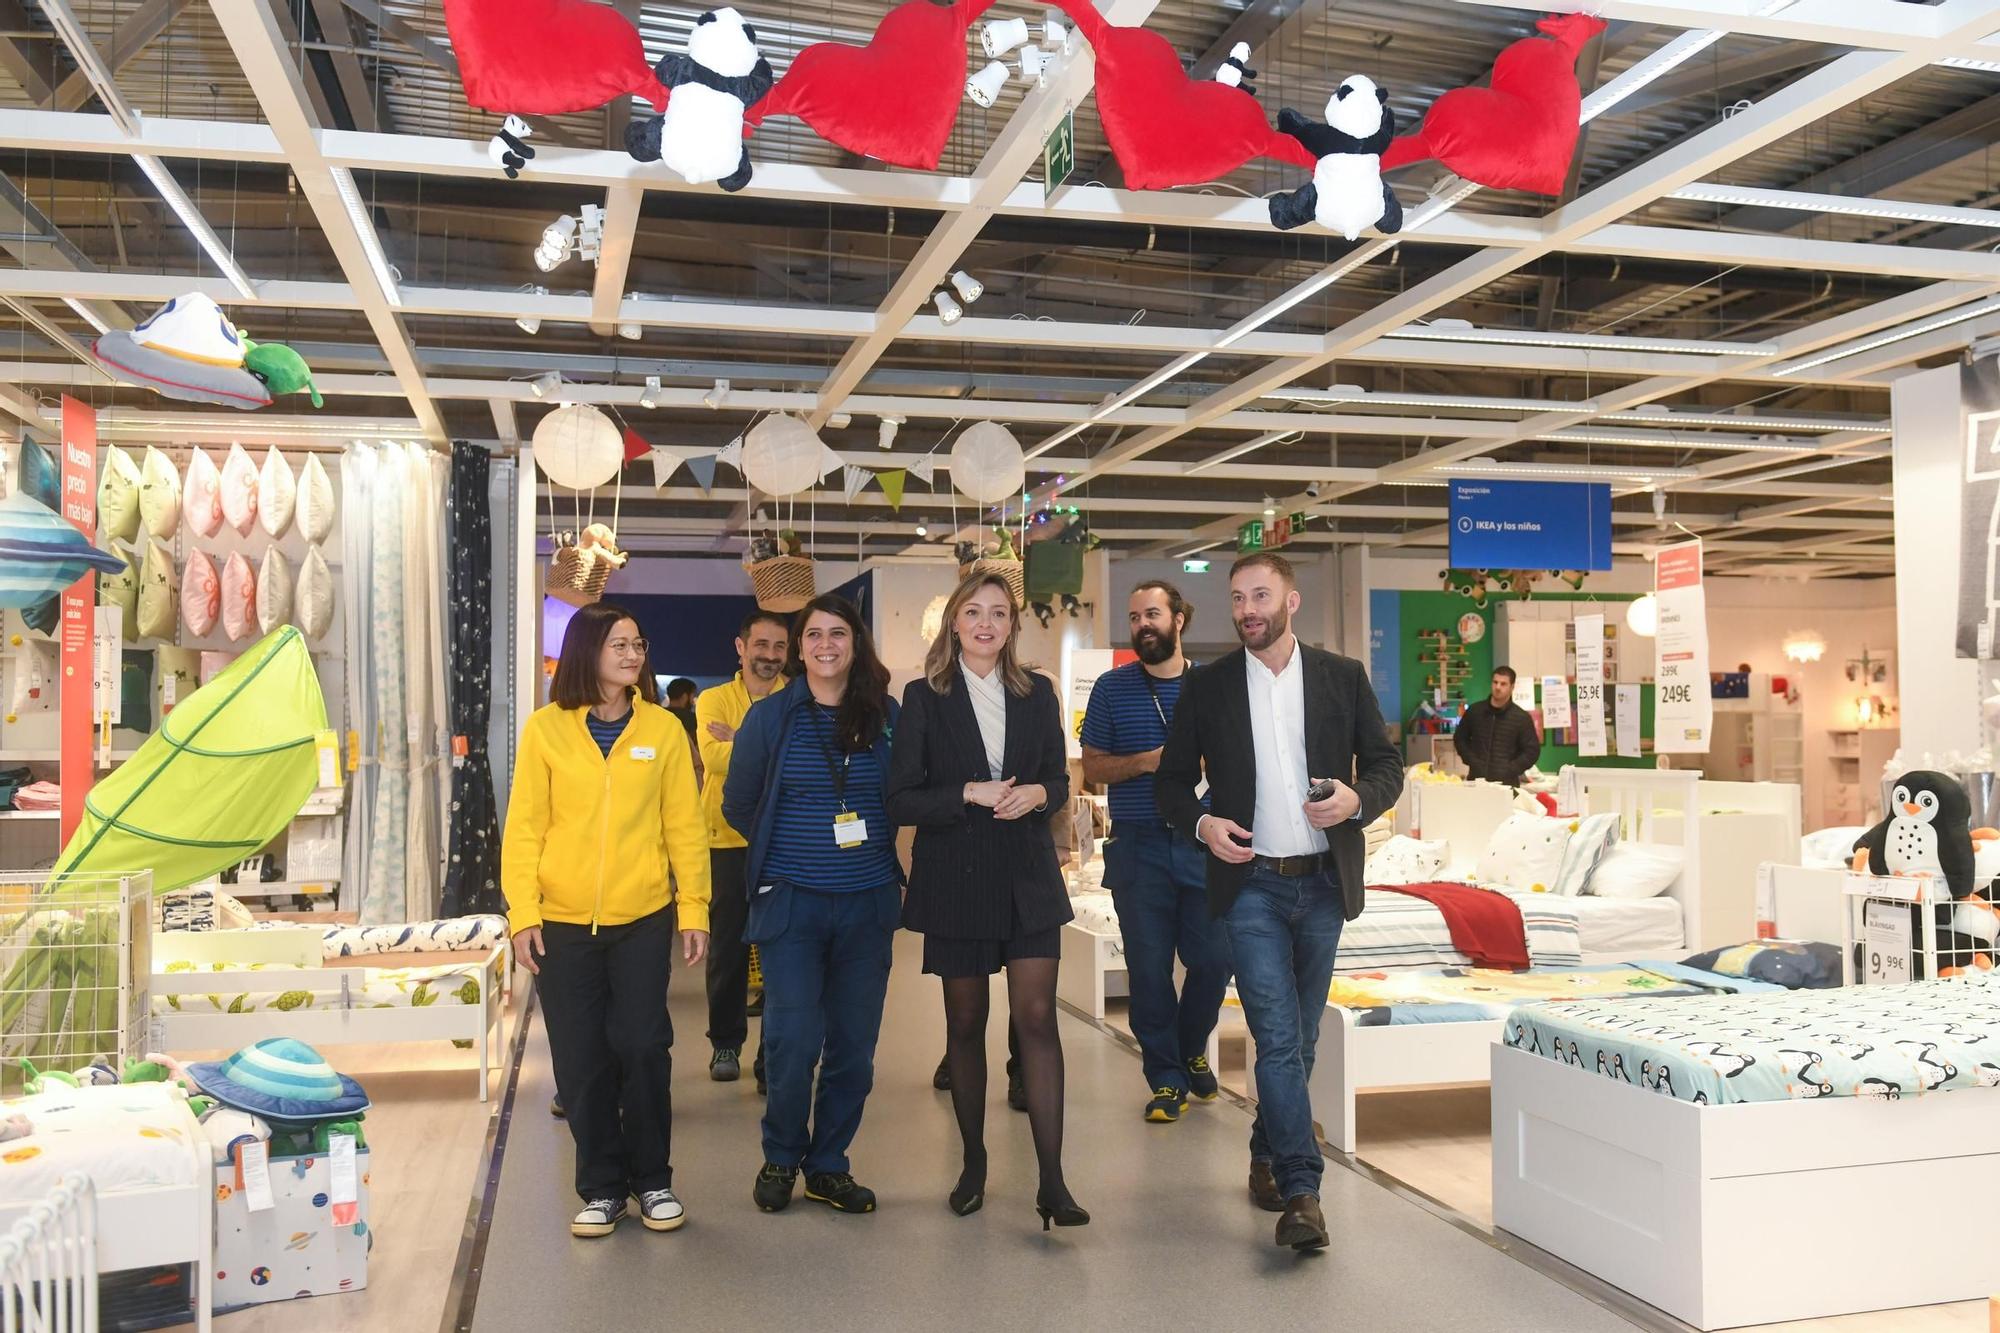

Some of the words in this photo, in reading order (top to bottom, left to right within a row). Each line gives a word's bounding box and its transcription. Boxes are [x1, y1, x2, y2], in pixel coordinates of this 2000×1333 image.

[67, 440, 91, 469] Nuestro
[67, 474, 86, 496] precio
[1458, 486, 1491, 495] Exposición
[67, 500, 80, 520] más
[1476, 521, 1495, 529] IKEA
[1497, 523, 1502, 532] y
[1504, 521, 1516, 530] los
[1518, 521, 1541, 531] niños
[1661, 665, 1677, 677] 299€
[1662, 684, 1691, 702] 249€
